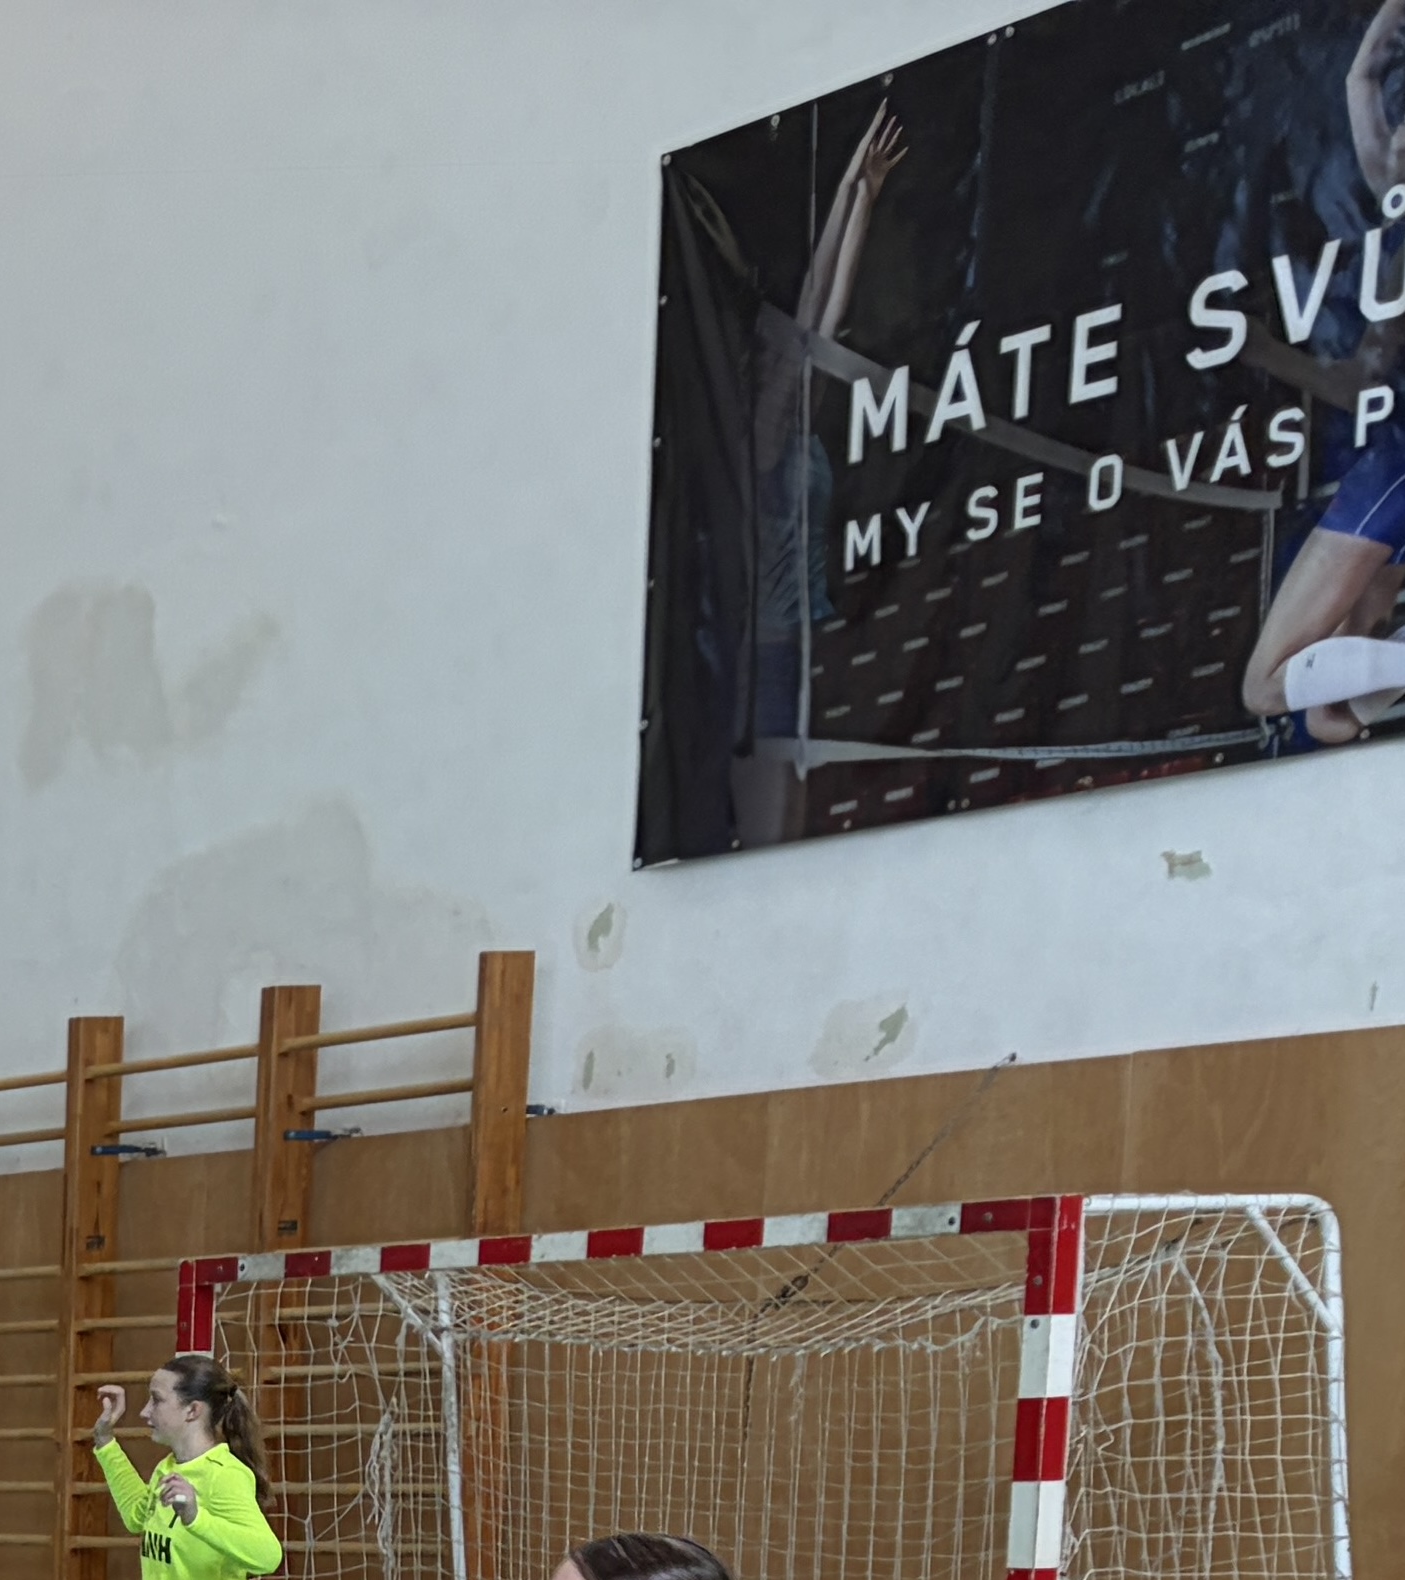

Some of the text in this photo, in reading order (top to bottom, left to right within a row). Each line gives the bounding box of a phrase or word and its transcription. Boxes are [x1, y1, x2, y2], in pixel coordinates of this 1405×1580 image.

[847, 303, 1123, 465] MÁTE
[843, 501, 931, 572] MY
[966, 472, 1044, 541] SE
[1087, 453, 1123, 513] O
[1165, 404, 1305, 491] VÁS
